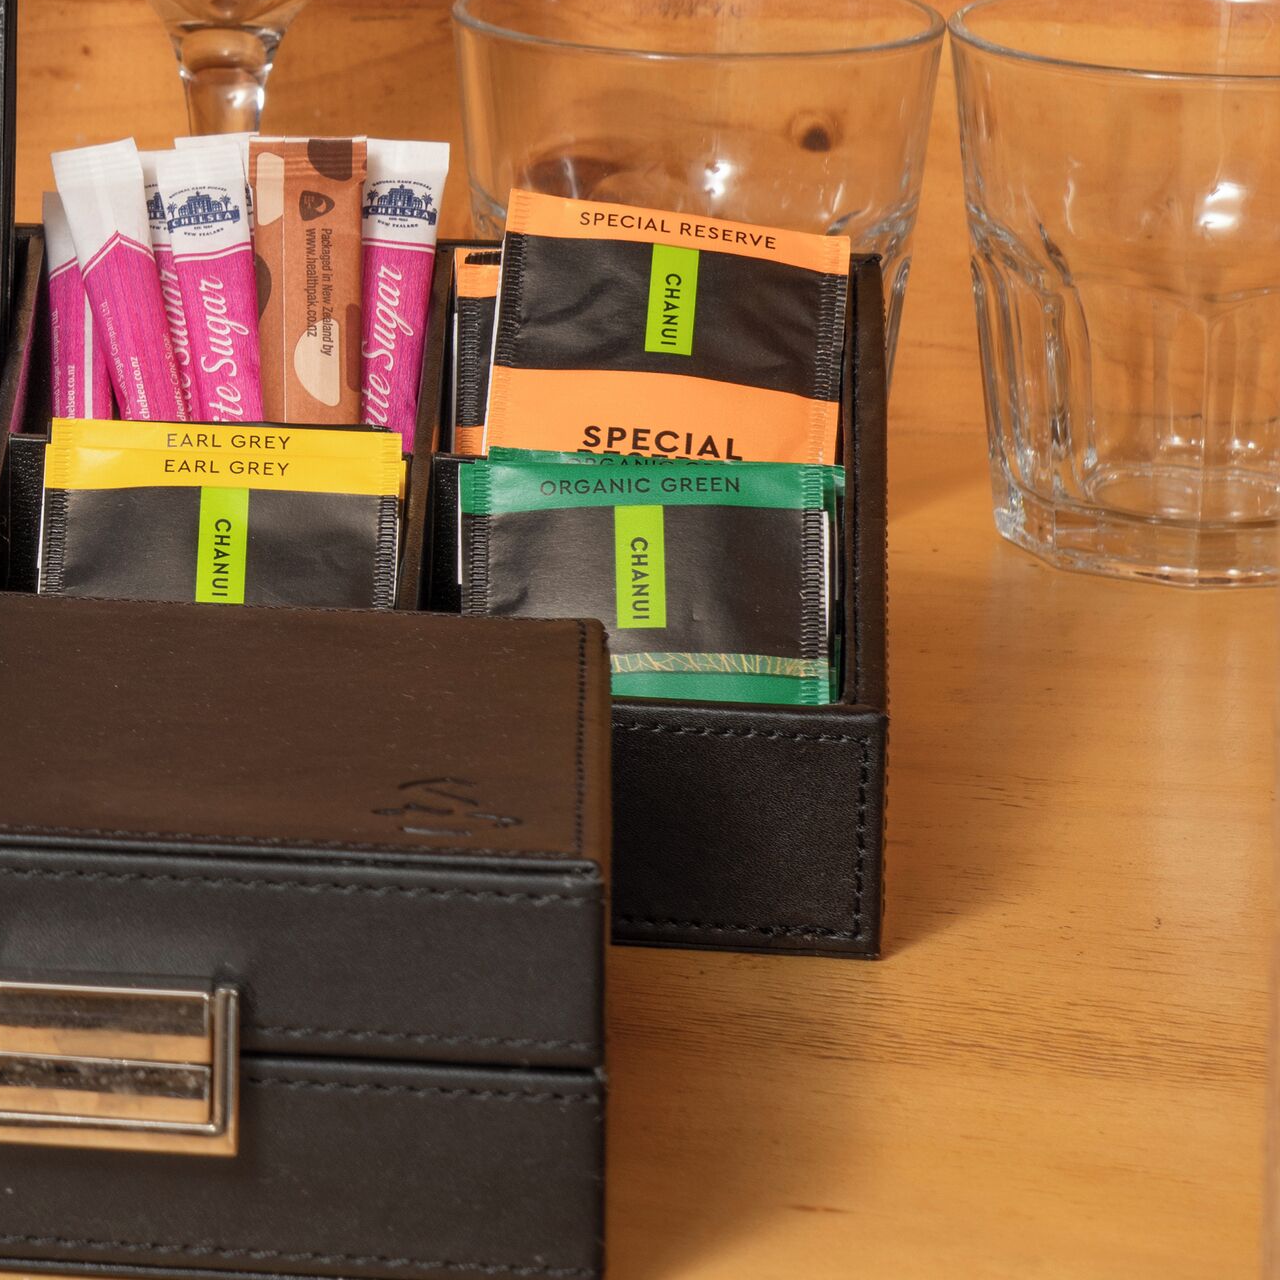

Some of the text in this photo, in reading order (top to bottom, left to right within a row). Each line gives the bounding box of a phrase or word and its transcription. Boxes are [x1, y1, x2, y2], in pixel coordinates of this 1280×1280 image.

[171, 212, 232, 226] CHELSEA
[368, 206, 429, 219] CHELSEA
[579, 212, 776, 250] SPECIAL RESERVE
[304, 228, 318, 337] www.healthpak.co.nz
[320, 228, 334, 357] Packaged in New Zealand by
[660, 273, 682, 346] CHANUI
[199, 274, 250, 377] Sugar
[361, 263, 414, 372] Sugar
[164, 459, 289, 476] EARL GREY
[167, 433, 290, 450] EARL GREY
[582, 425, 743, 461] SPECIAL
[540, 477, 740, 496] ORGANIC GREEN
[211, 518, 232, 597] CHANUI
[630, 536, 650, 620] CHANUI
